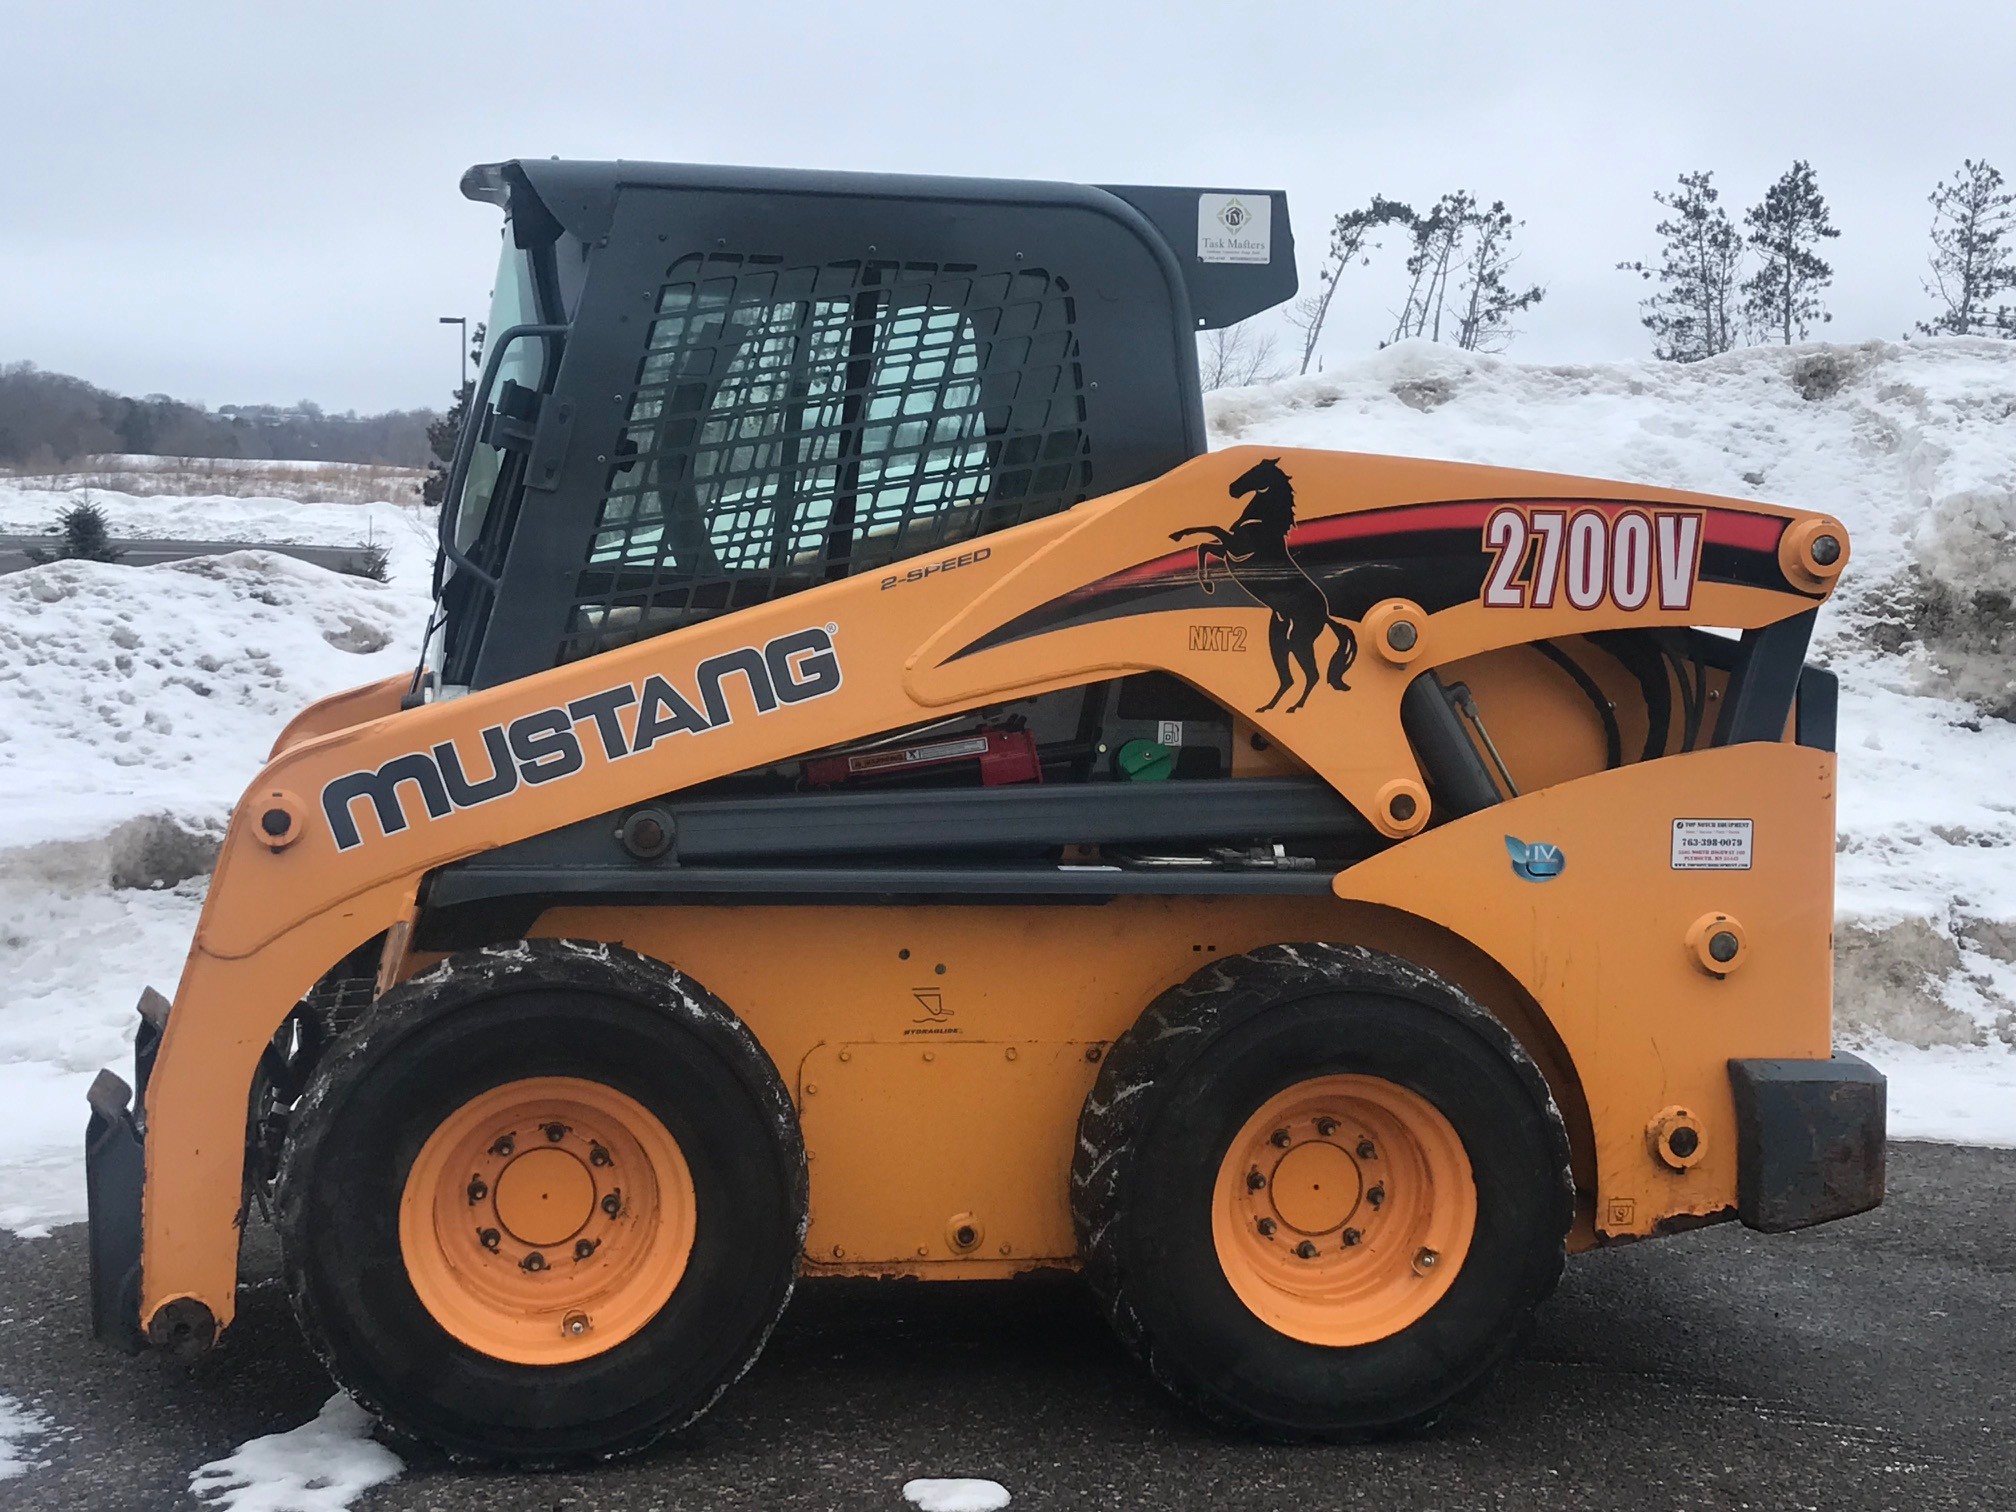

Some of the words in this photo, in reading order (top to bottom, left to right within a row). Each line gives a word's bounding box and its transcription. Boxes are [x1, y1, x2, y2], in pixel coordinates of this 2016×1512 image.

[1202, 238, 1225, 248] Task
[1228, 239, 1266, 250] Masters
[881, 548, 991, 591] 2-SPEED
[1484, 508, 1705, 610] 2700V
[1189, 626, 1247, 651] NXT2
[321, 625, 843, 853] MUSTANG
[1682, 838, 1743, 847] 763-398-0079
